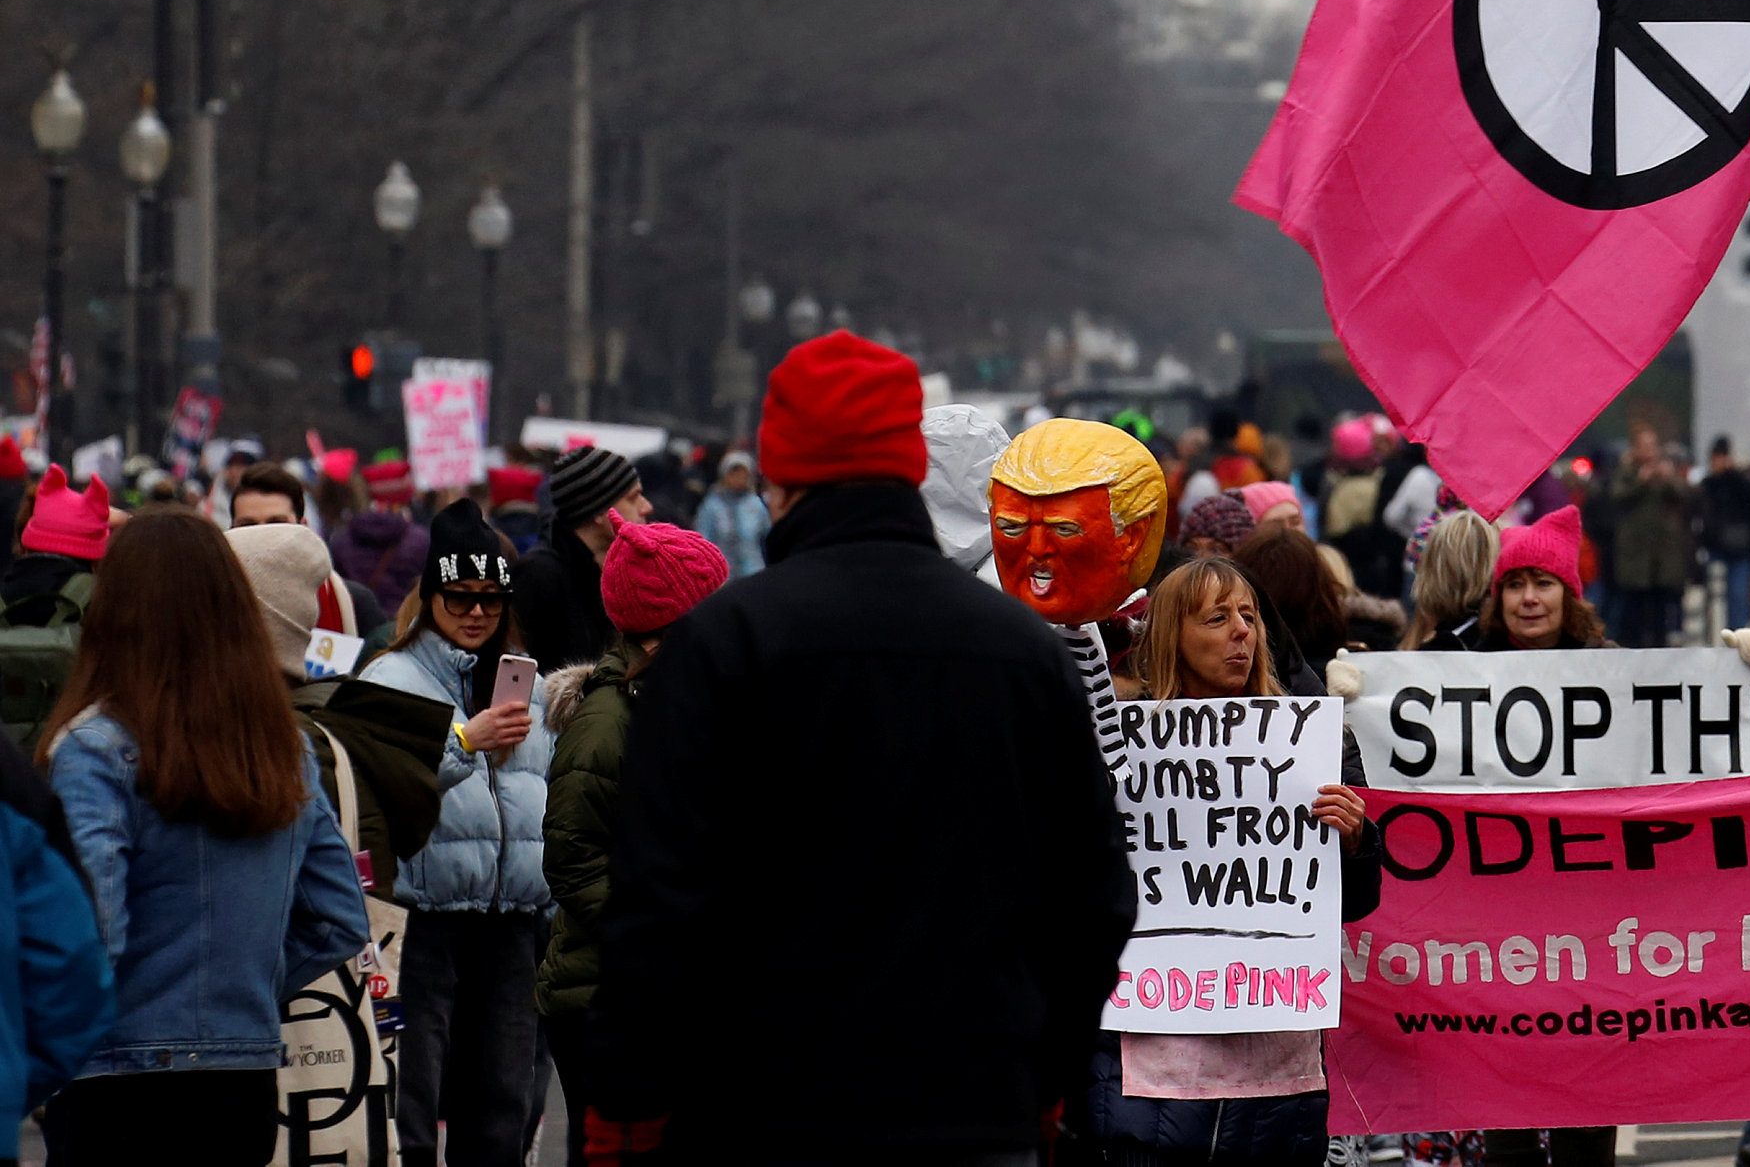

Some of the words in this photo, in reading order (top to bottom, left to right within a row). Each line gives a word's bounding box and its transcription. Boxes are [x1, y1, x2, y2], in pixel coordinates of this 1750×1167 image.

[439, 553, 511, 586] NYC
[1120, 699, 1321, 750] RUMPTY
[1389, 686, 1612, 778] STOP
[1119, 806, 1188, 852] ELL
[1206, 804, 1331, 851] FROM
[1181, 856, 1320, 914] WALL!
[1609, 917, 1716, 977] for
